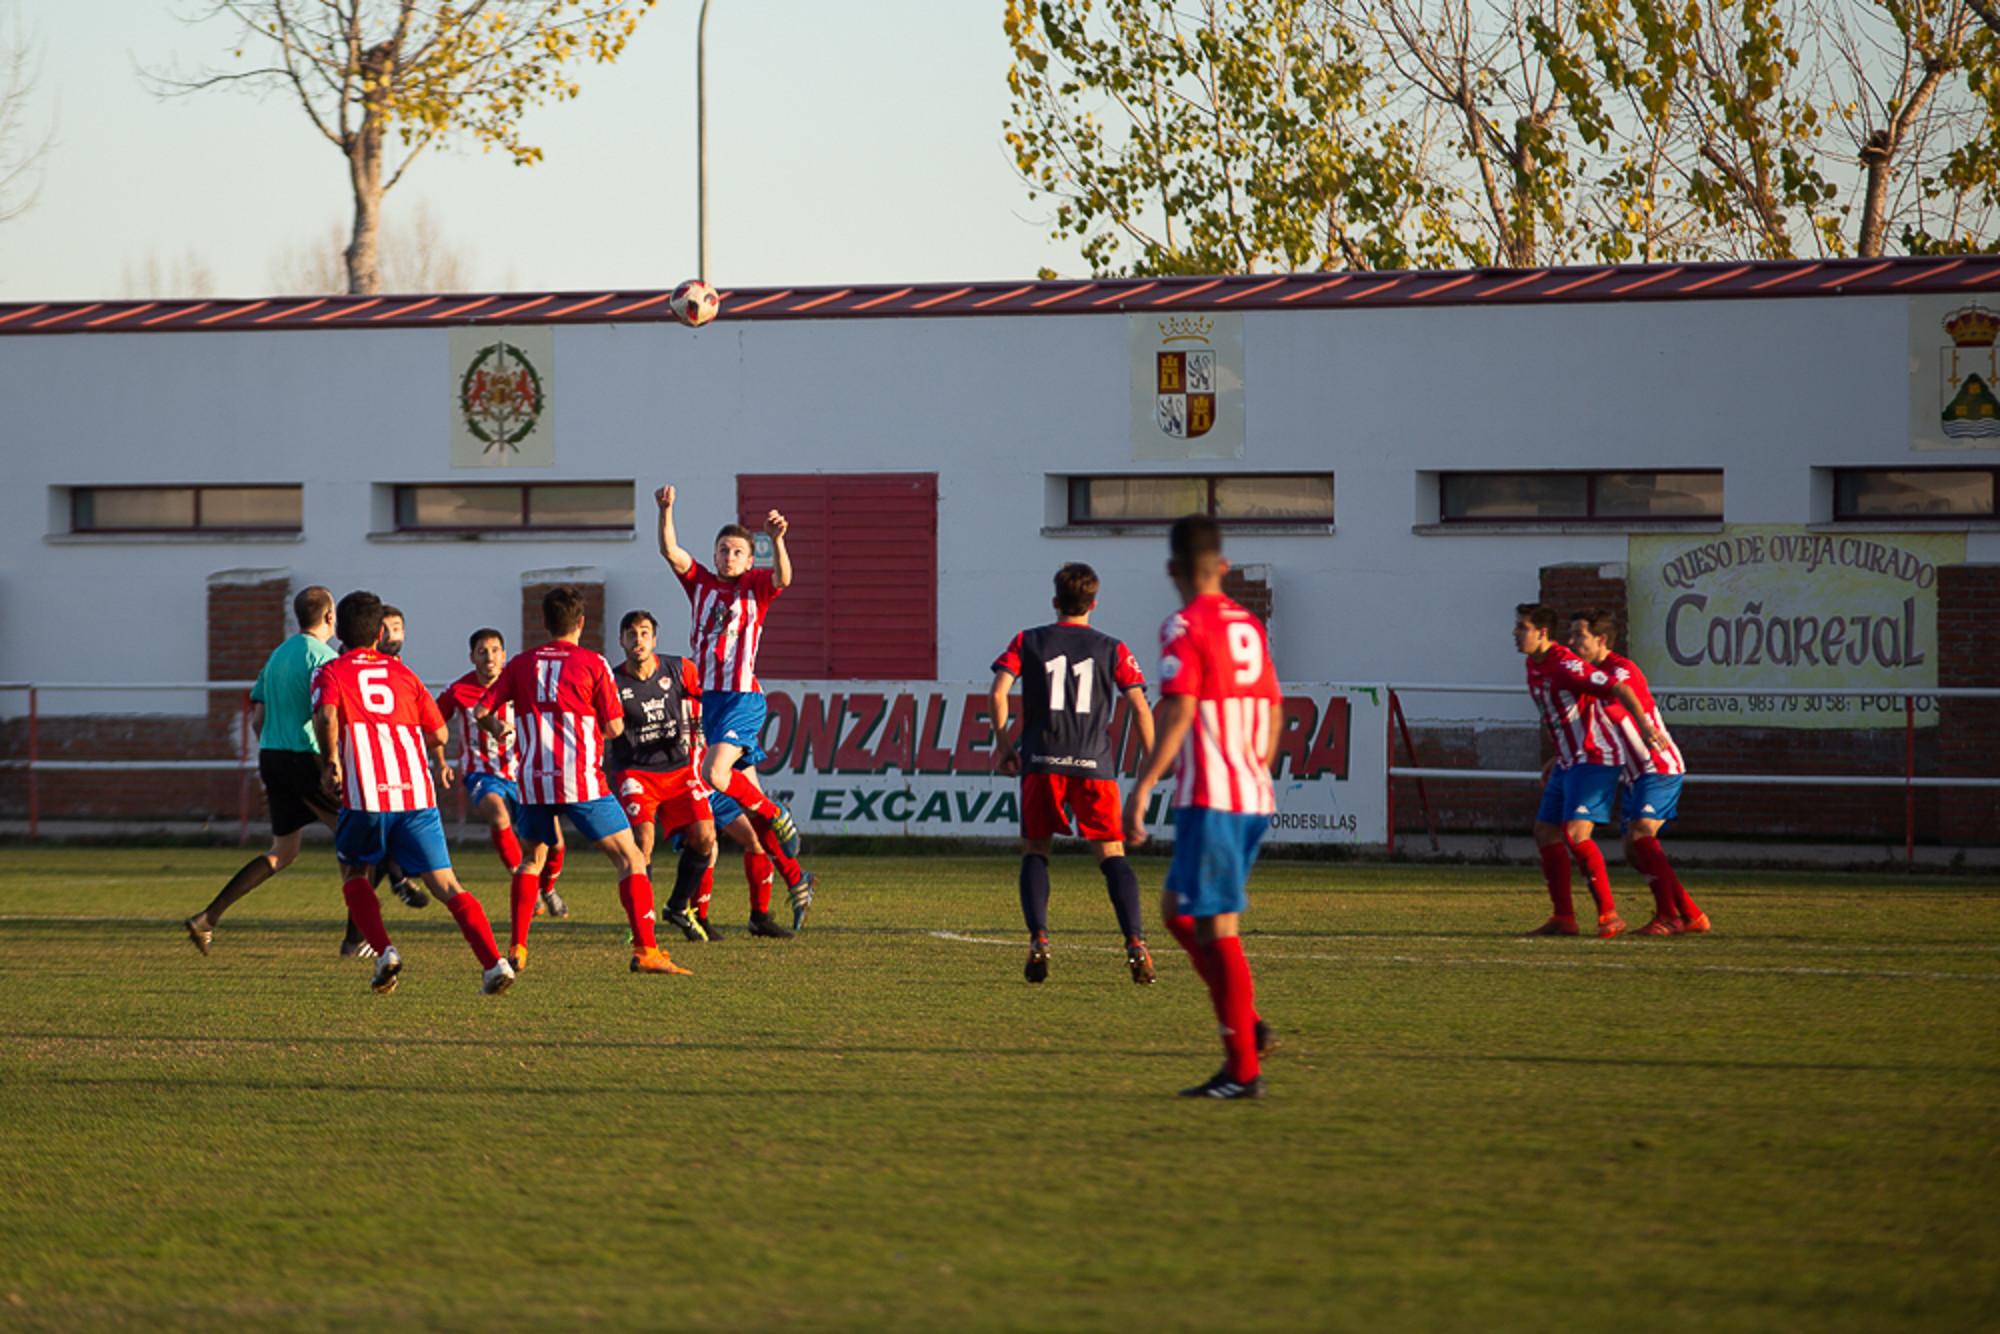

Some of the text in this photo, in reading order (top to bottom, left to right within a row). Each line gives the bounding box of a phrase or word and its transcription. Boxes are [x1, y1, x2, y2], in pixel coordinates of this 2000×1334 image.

[1663, 535, 1934, 589] QUESO DE OVEJA CURADO
[1227, 622, 1264, 685] 9
[358, 667, 395, 714] 6
[536, 659, 562, 702] 11
[1045, 655, 1095, 713] 11
[1748, 694, 1775, 711] 983
[1781, 694, 1798, 711] 79
[1803, 694, 1822, 711] 30
[757, 691, 1024, 776] ONZALEZ
[1271, 813, 1357, 833] ORDESILLAS
